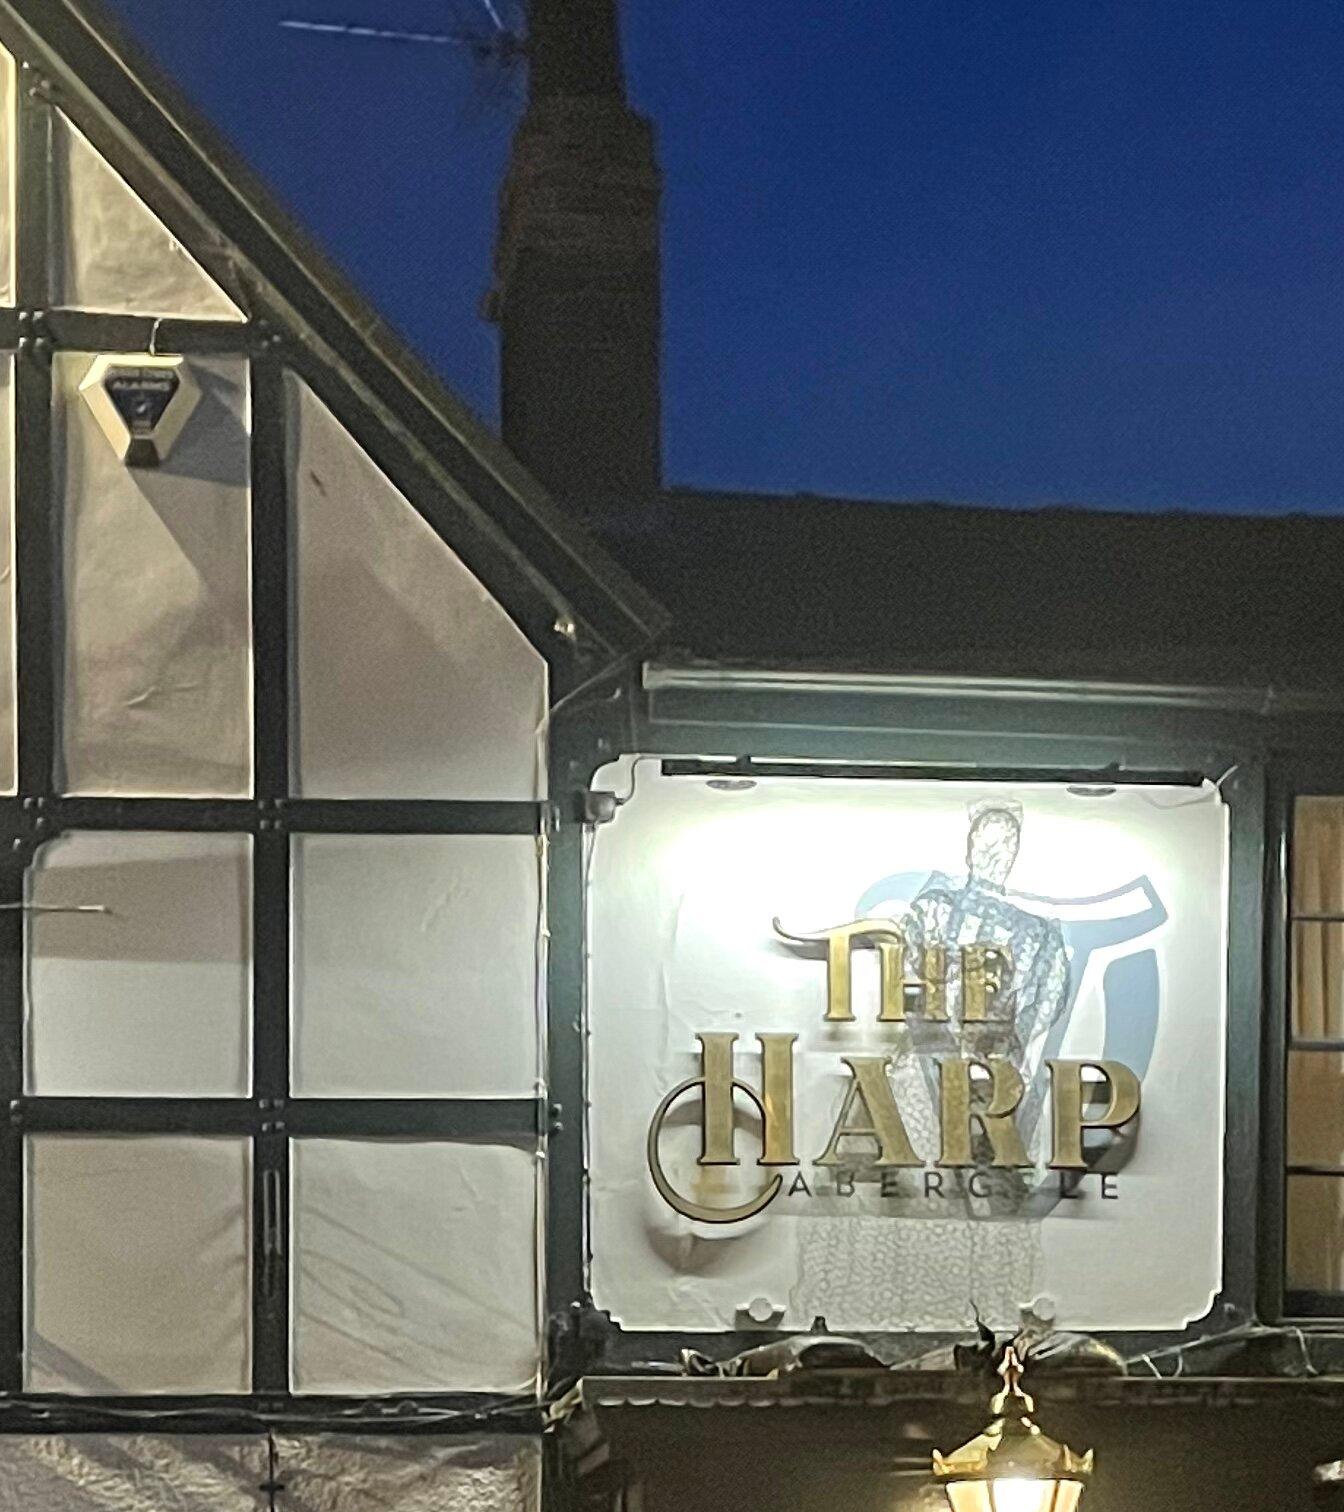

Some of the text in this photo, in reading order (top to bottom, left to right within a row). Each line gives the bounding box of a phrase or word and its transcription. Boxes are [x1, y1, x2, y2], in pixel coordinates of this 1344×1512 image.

[772, 915, 1017, 1022] THE
[647, 1032, 1143, 1224] HARP
[787, 1170, 1120, 1200] ABERGLE
